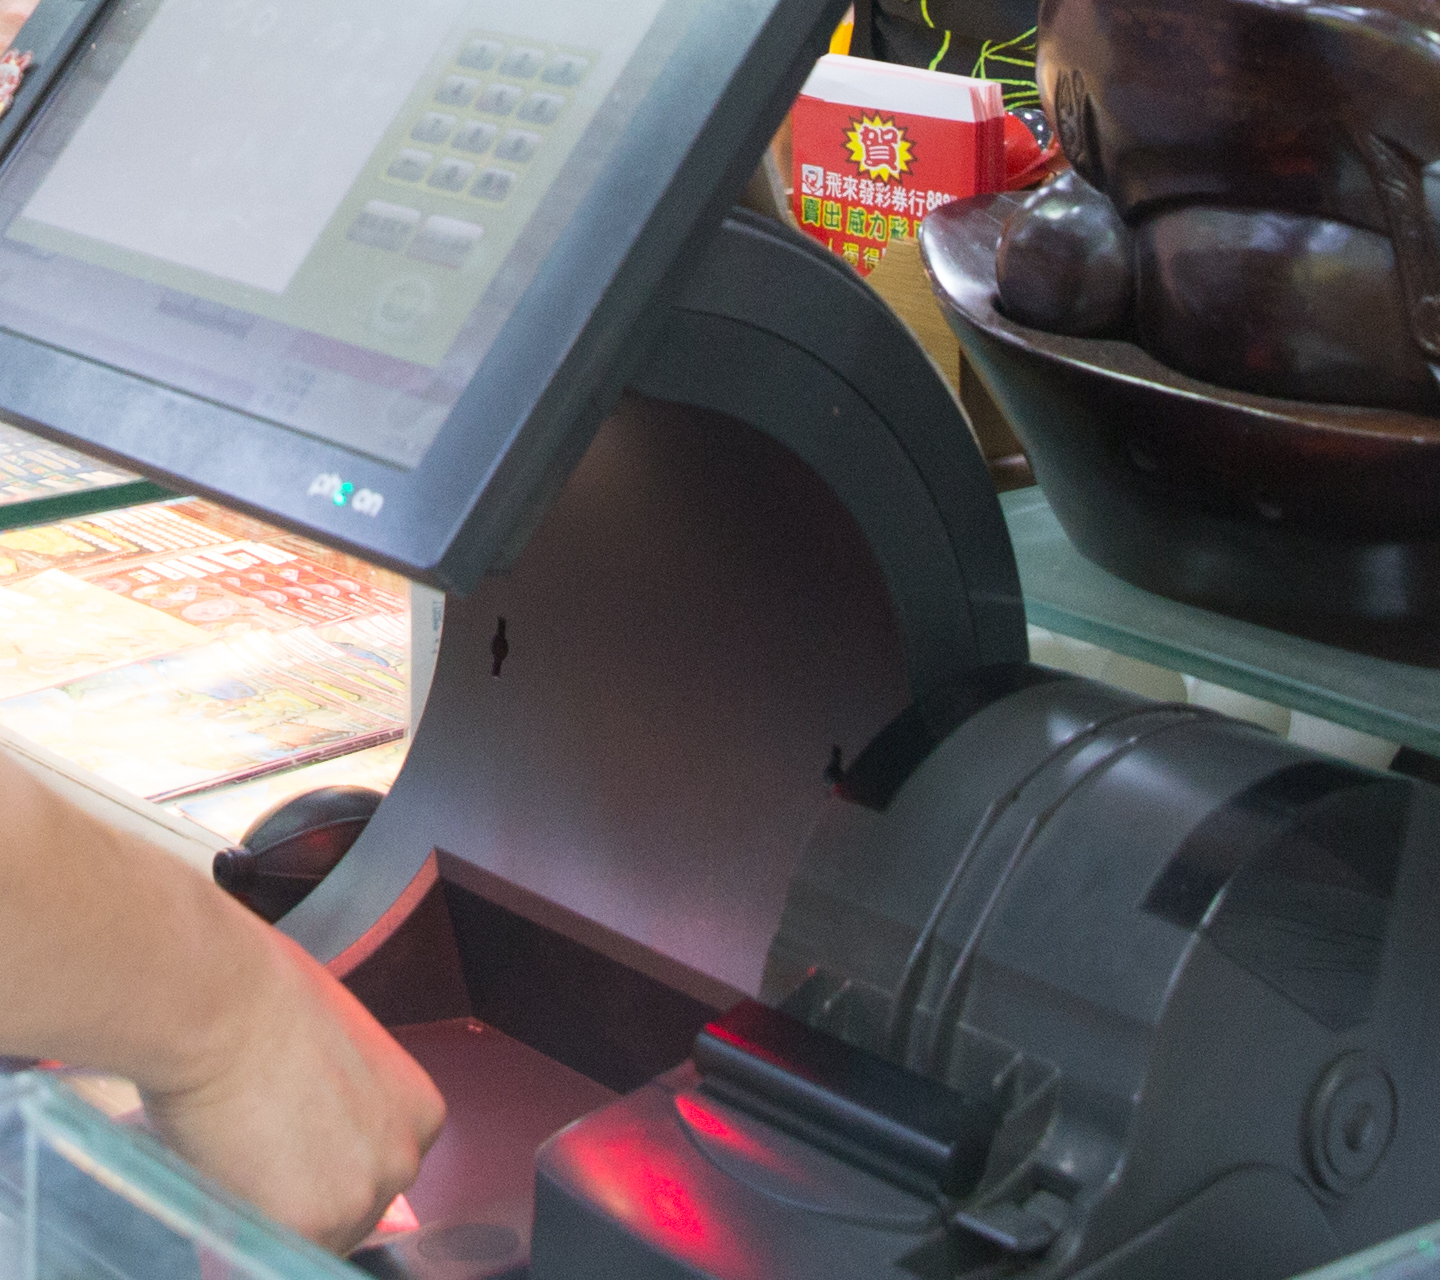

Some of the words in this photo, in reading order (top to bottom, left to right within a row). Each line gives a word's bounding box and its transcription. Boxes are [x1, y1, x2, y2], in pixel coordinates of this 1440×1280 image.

[858, 123, 901, 174] 賀
[825, 170, 926, 217] 飛來發彩券行
[802, 195, 843, 231] 賣出
[846, 206, 909, 242] 威力彩
